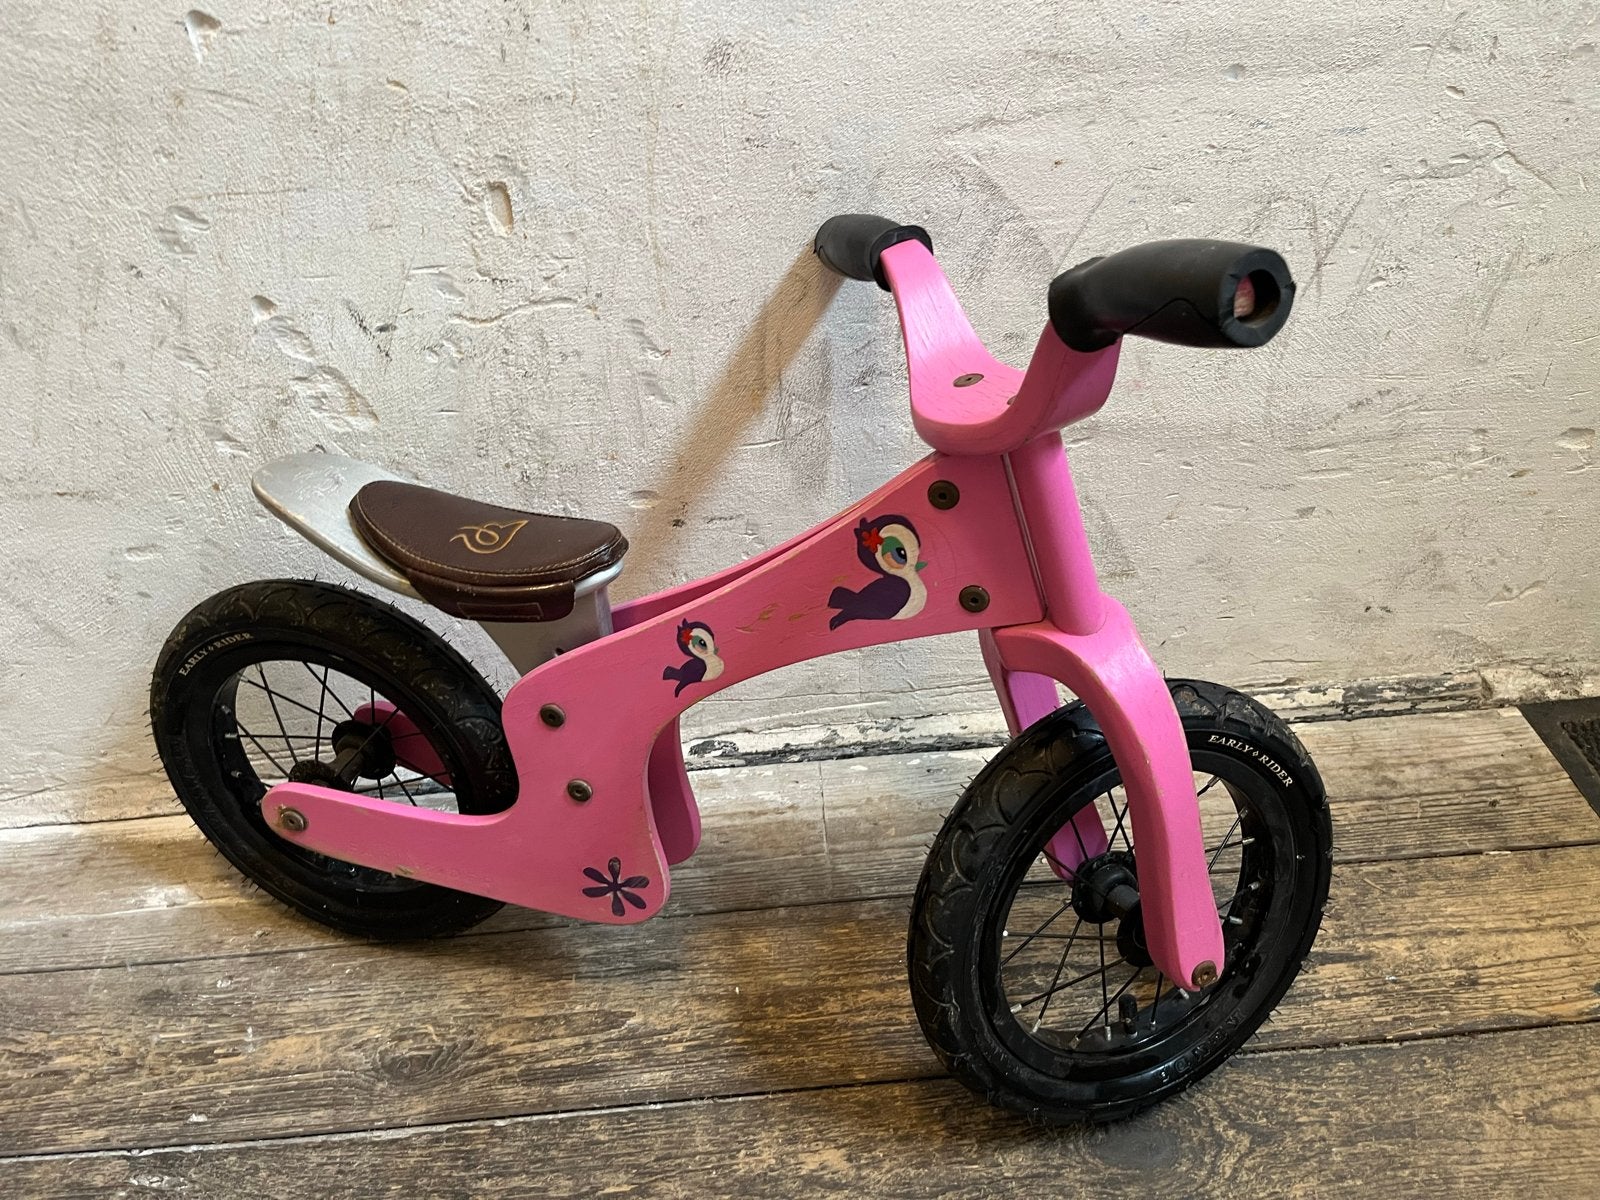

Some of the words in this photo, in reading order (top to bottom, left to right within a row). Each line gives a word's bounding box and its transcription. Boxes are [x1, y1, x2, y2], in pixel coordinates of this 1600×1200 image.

[178, 647, 209, 677] EARLY
[213, 632, 254, 649] RIDER
[1207, 734, 1254, 753] EARLY
[1258, 754, 1294, 788] RIDER
